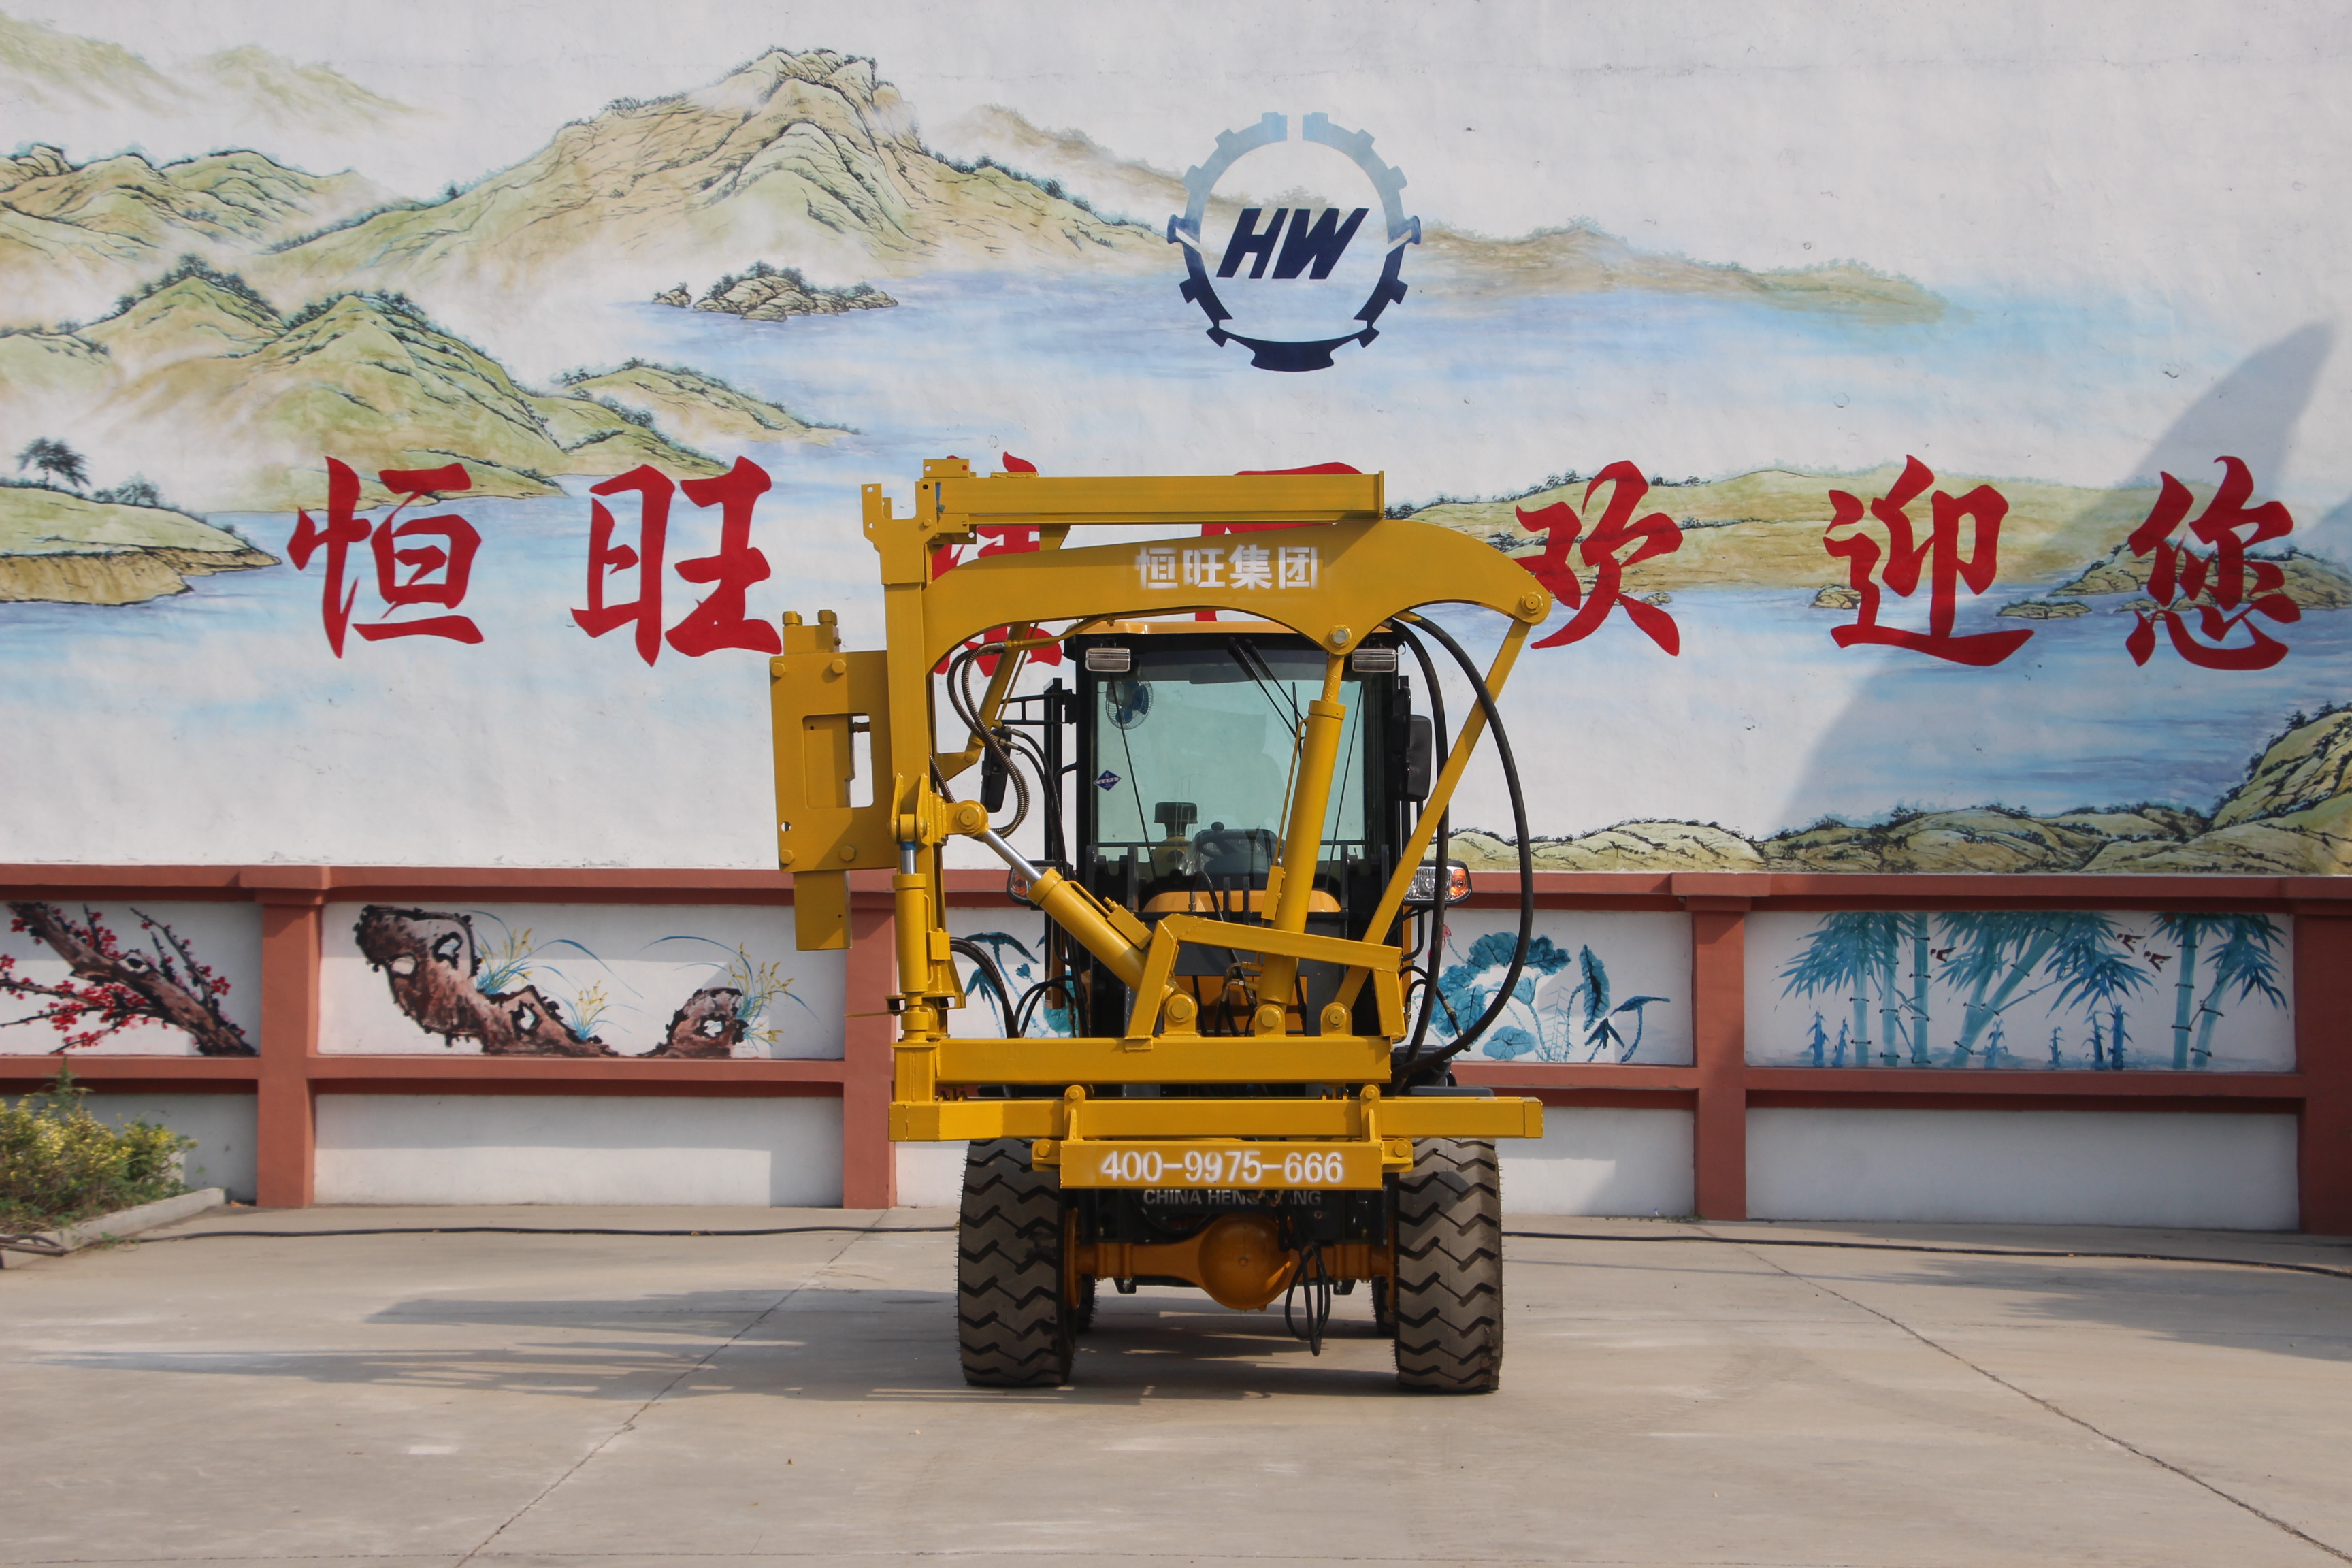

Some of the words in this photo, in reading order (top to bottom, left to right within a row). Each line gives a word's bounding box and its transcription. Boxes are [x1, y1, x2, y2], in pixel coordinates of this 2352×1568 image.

[1216, 208, 1369, 280] HW
[287, 451, 2302, 670] 恒旺欢迎您
[1134, 544, 1318, 590] 恒旺集团
[1101, 1150, 1343, 1183] 400-9975-666
[1143, 1189, 1202, 1205] CHINA
[1207, 1189, 1322, 1205] HENNG
